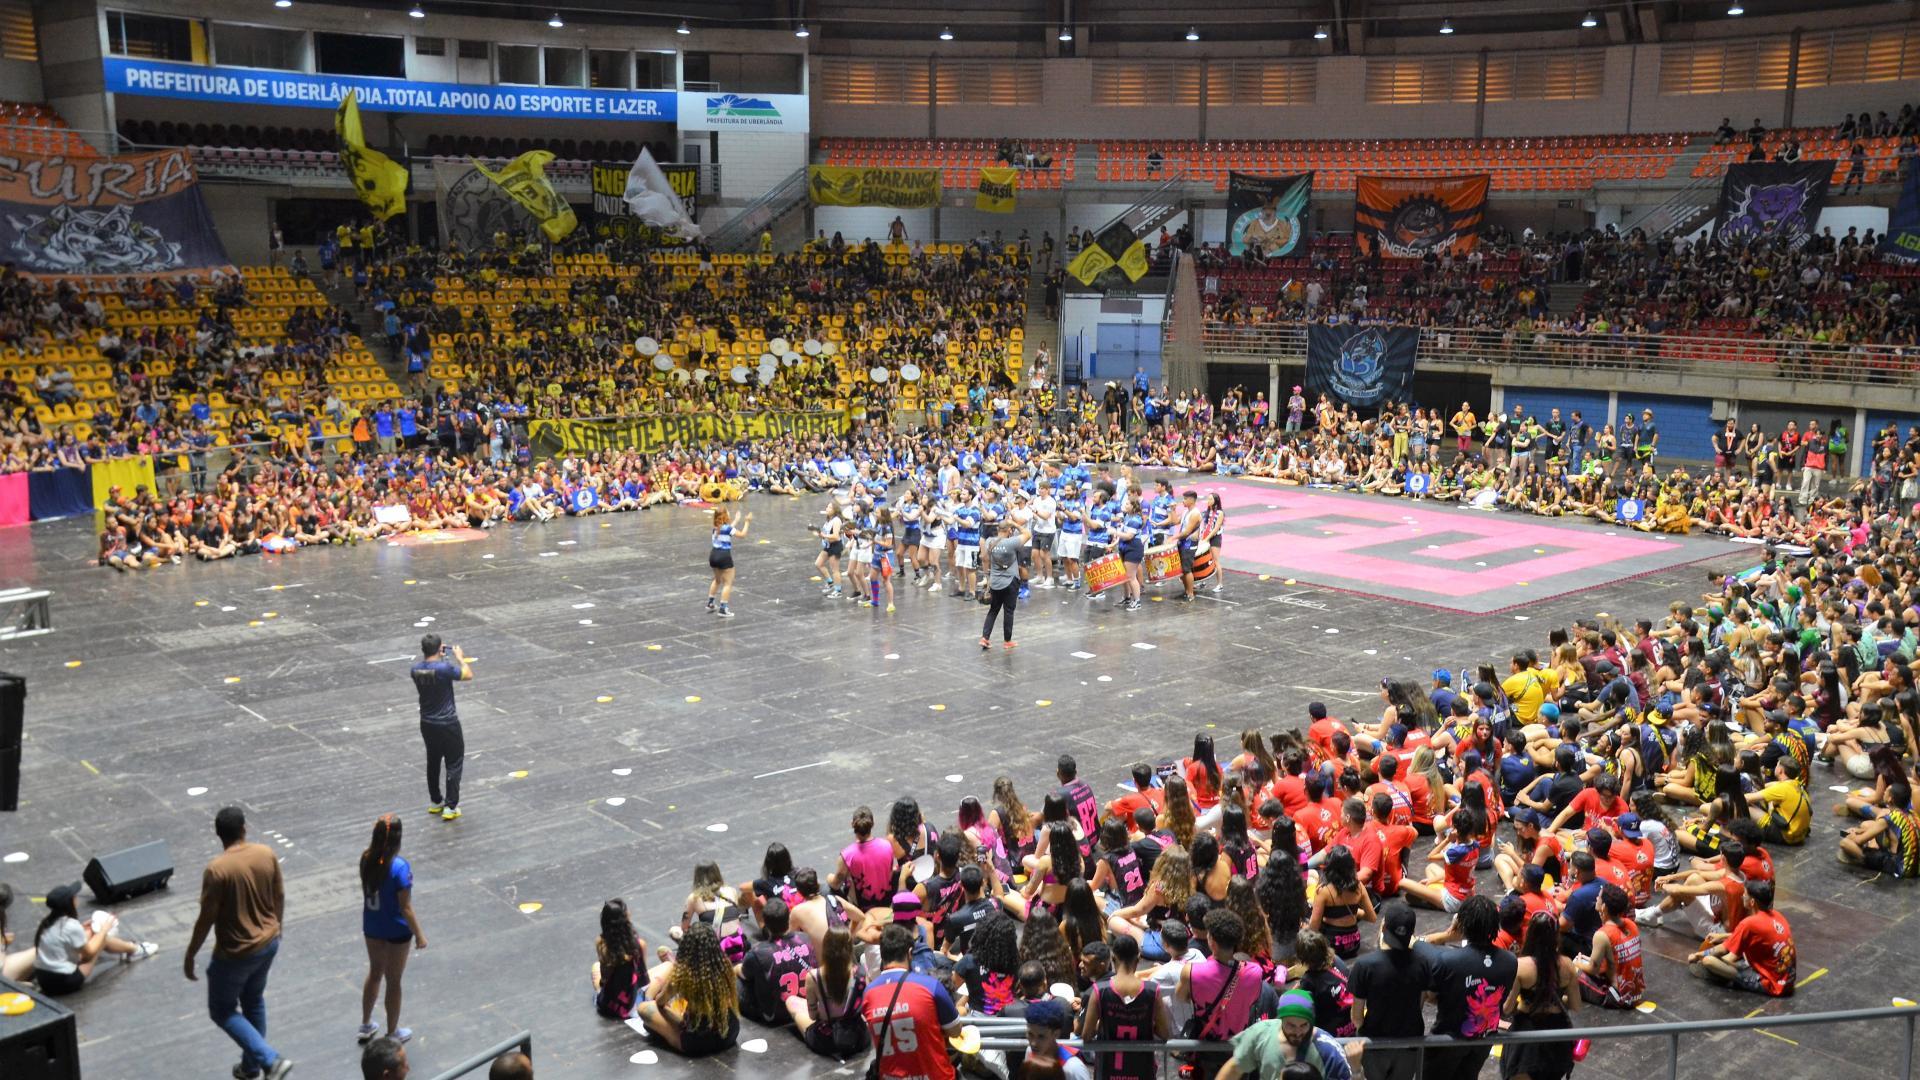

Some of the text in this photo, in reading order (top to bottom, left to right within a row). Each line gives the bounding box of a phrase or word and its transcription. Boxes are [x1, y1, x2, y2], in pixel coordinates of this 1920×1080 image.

[125, 68, 241, 95] PREFEITURA
[243, 78, 269, 98] DE
[438, 91, 490, 109] APOIO
[493, 93, 516, 111] AO
[520, 95, 592, 113] ESPORTE
[595, 97, 606, 113] E
[609, 98, 662, 116] LAZER.
[592, 166, 696, 198] ENGRIA
[979, 179, 1015, 198] BRASIL
[1377, 230, 1457, 258] ENGRENDA
[568, 416, 658, 454] SANGUE
[872, 1016, 919, 1057] 75
